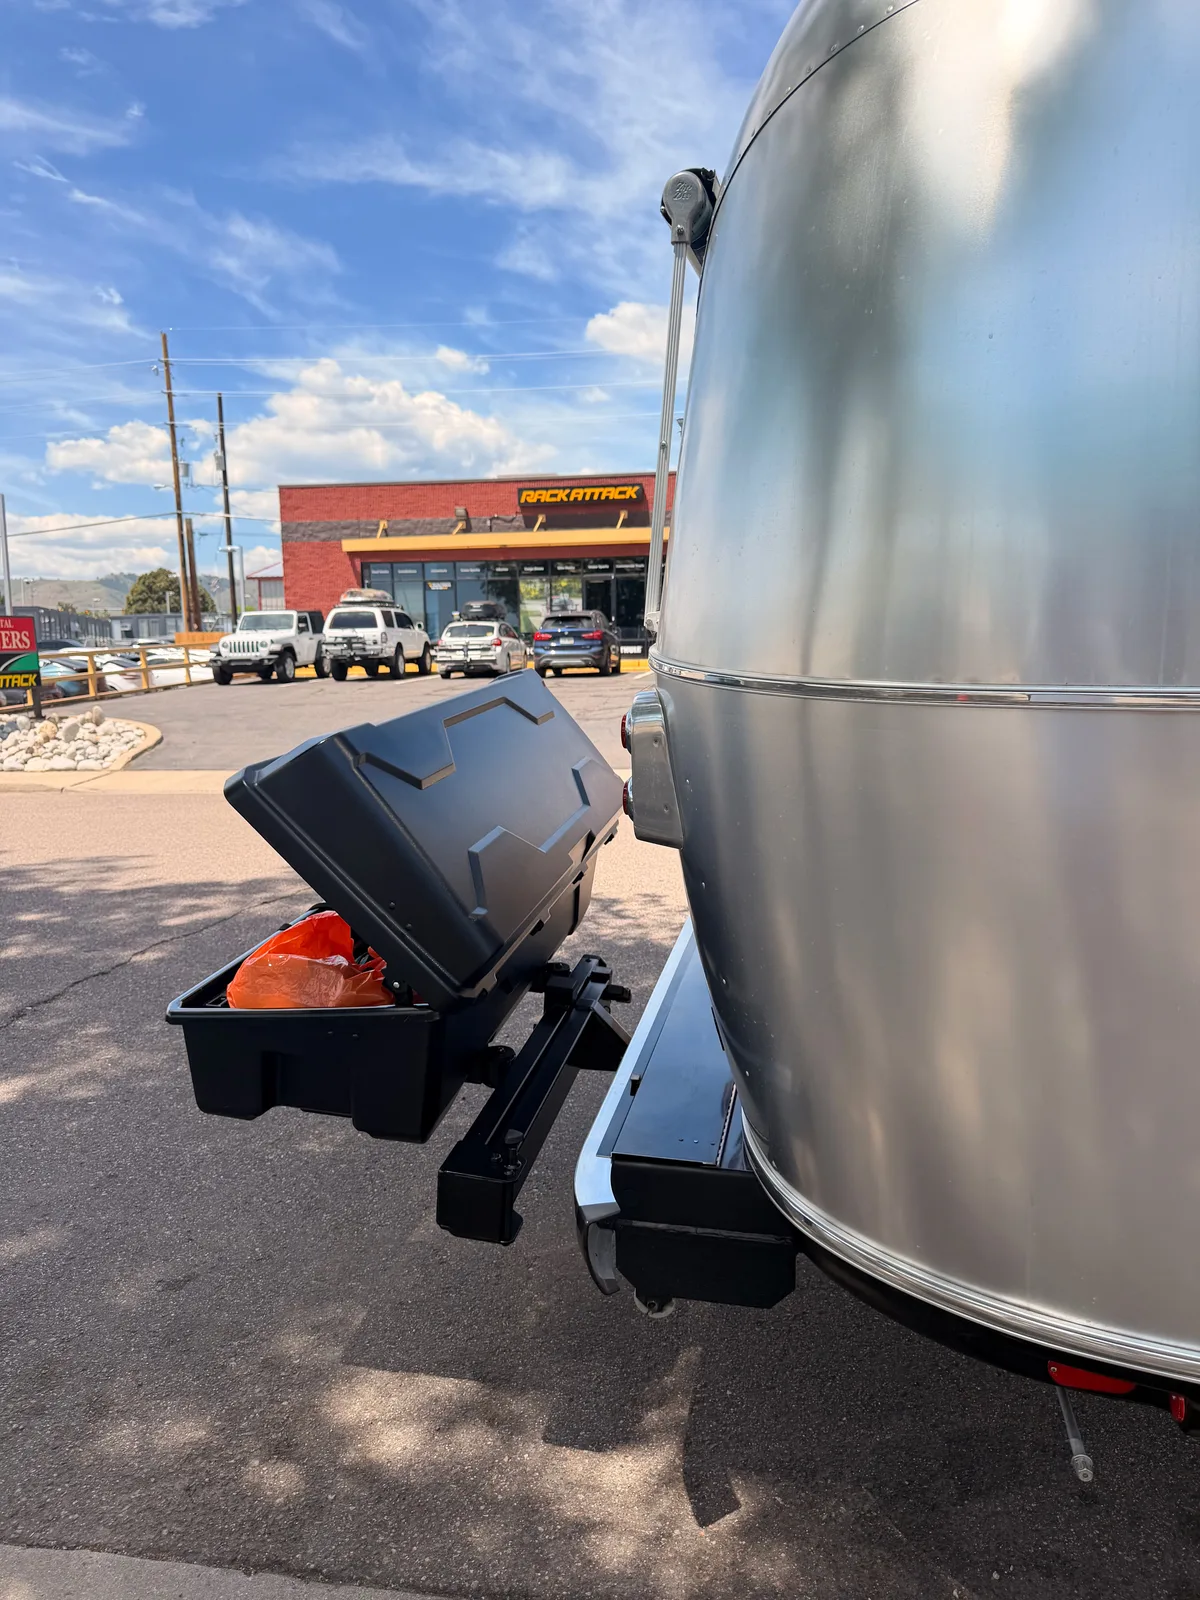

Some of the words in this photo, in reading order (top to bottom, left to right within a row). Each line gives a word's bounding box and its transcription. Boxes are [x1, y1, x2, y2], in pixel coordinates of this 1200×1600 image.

[520, 490, 571, 503] RACK
[570, 486, 639, 501] ATTACK
[1, 631, 30, 649] ERS
